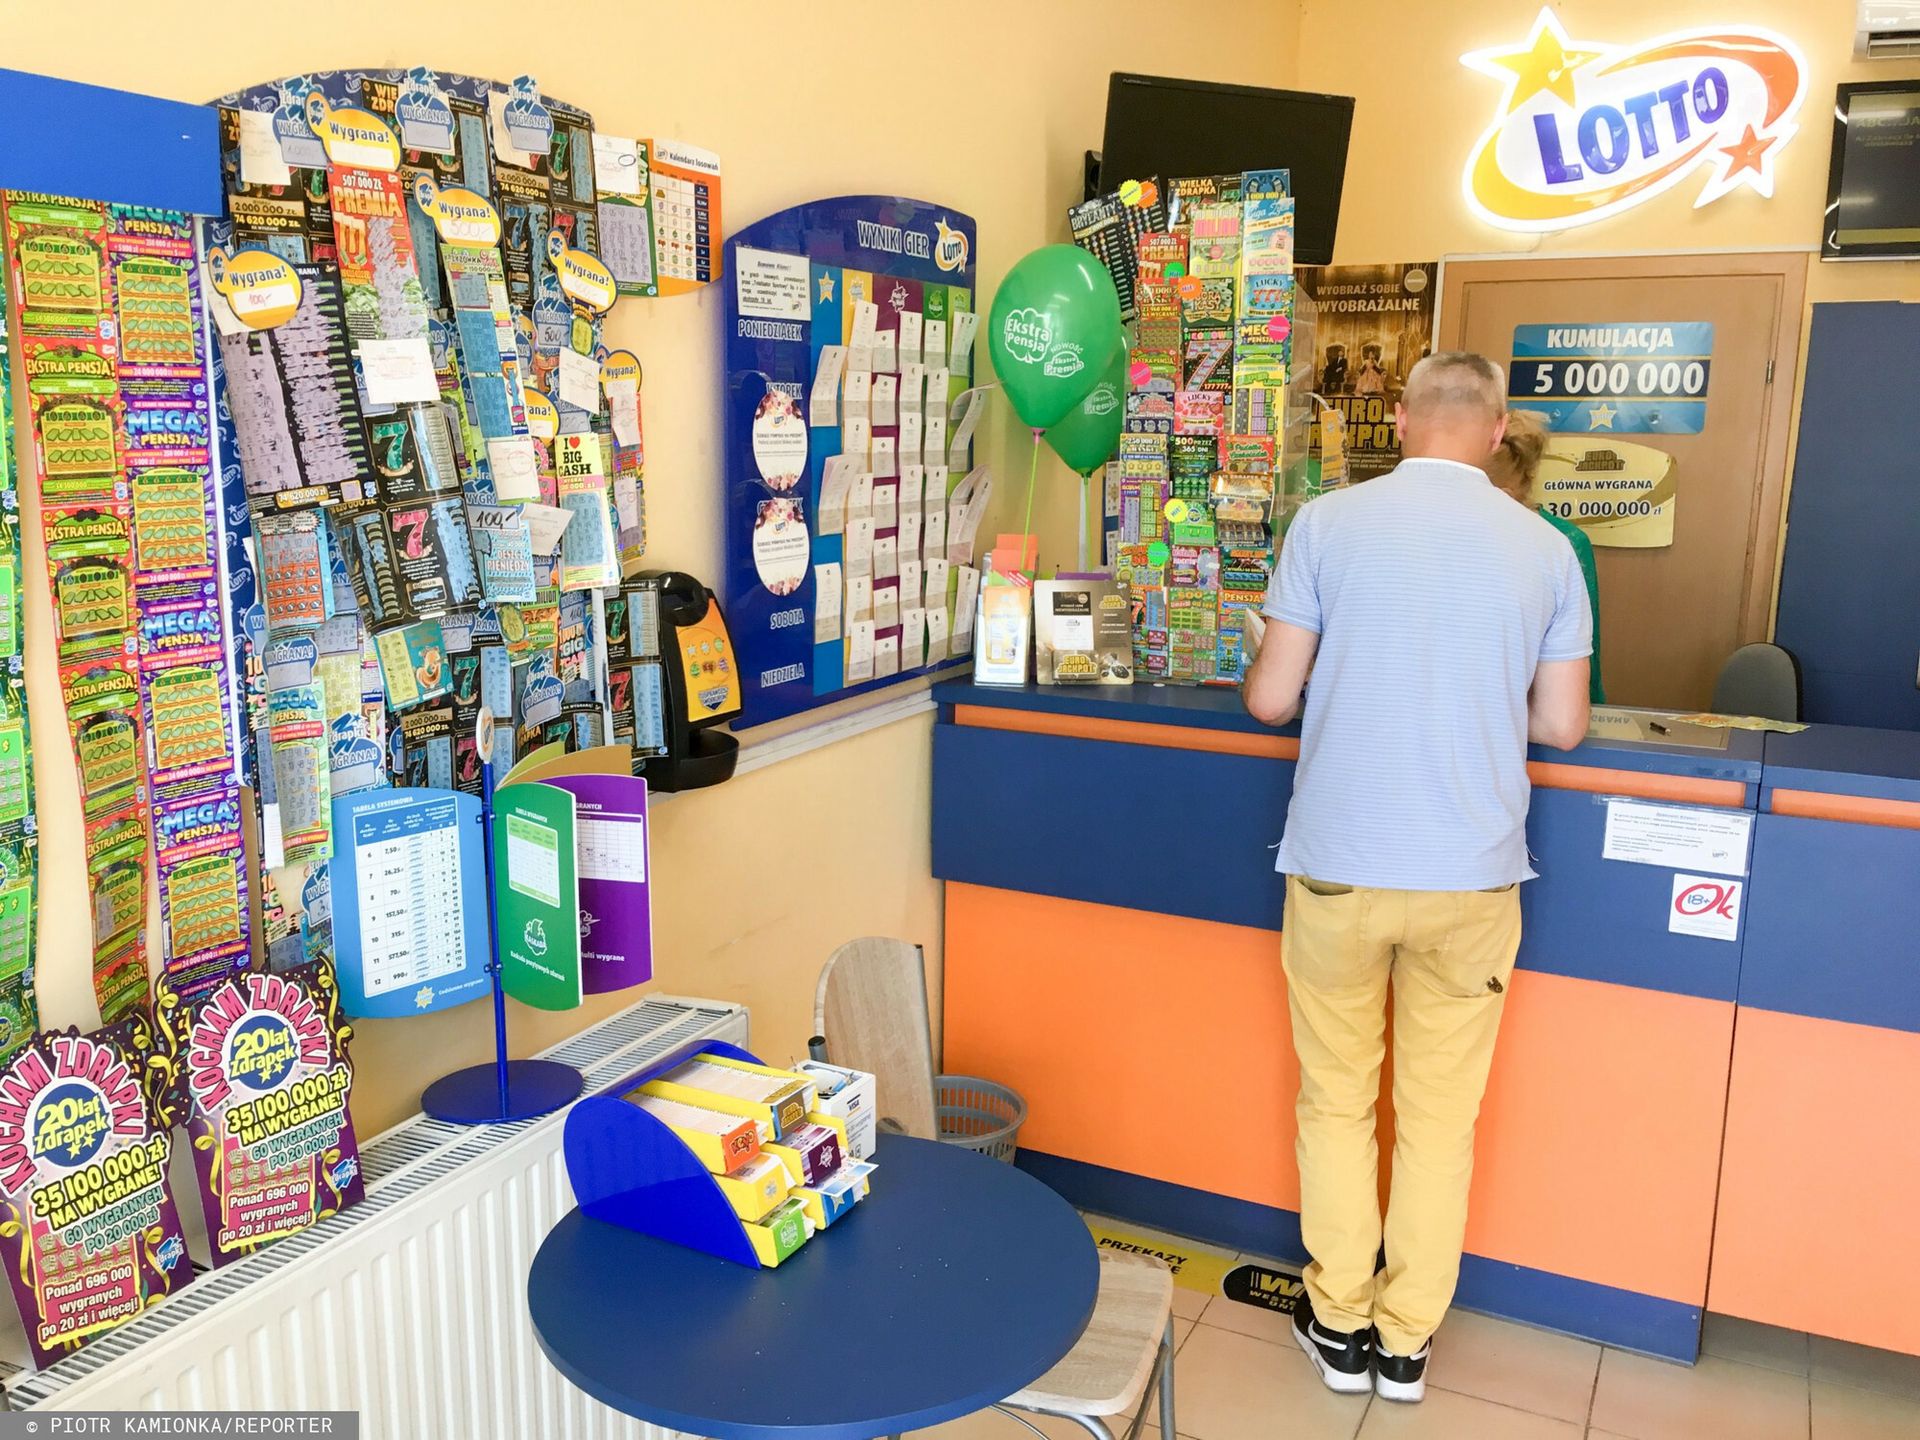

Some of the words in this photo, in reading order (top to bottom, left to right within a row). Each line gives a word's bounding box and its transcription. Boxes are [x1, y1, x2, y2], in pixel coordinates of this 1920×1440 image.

[401, 105, 450, 124] WYGRANA!
[507, 112, 551, 129] WYGRANA!
[1532, 66, 1729, 185] LOTTO
[329, 121, 391, 143] Wygrana!
[1175, 186, 1217, 197] ZDRAPKA
[1178, 179, 1213, 188] WIELKA
[6, 189, 50, 204] EKSTRA
[51, 194, 102, 212] PENSJA!
[235, 202, 241, 211] 2
[241, 202, 260, 212] 000
[263, 204, 284, 215] 000
[333, 185, 403, 217] PREMIA
[438, 202, 491, 219] Wygrana!
[124, 220, 173, 237] PENSJA
[234, 214, 245, 224] 74
[246, 215, 264, 226] 620
[266, 216, 287, 227] 000
[857, 220, 902, 254] WYNIKI
[905, 234, 931, 259] GIER
[942, 242, 962, 262] LOTTO
[1141, 245, 1185, 261] PREMIA
[229, 266, 287, 288] Wygrana!
[564, 257, 609, 286] Wygrana!
[1255, 278, 1283, 287] LUCKY
[1317, 284, 1366, 296] WYOBRAŹ
[1370, 284, 1400, 294] SOBIE
[1194, 299, 1221, 310] KASY
[1296, 296, 1420, 313] NIEWYOBRAŻALNE
[738, 319, 804, 341] PONIEDZIAŁEK
[1006, 318, 1050, 342] Ekstra
[1547, 327, 1674, 353] KUMULACJA
[1007, 332, 1045, 352] Pensja
[26, 358, 65, 376] EKSTRA
[67, 359, 116, 378] PENSJA!
[606, 365, 637, 380] Wygrana!
[1046, 361, 1084, 374] Premia
[1534, 363, 1554, 394] 5
[1564, 362, 1629, 395] 000
[1637, 362, 1705, 395] 000
[126, 410, 203, 436] MEGA
[140, 433, 191, 447] PENSJA
[564, 437, 569, 450] I
[1175, 437, 1194, 446] 500
[563, 450, 582, 464] BIG
[558, 463, 592, 478] CASH
[1544, 479, 1591, 490] GŁÓWNA
[1594, 480, 1653, 489] WYGRANA
[1537, 502, 1572, 518] 30
[1579, 502, 1612, 516] 000
[1616, 502, 1650, 516] 000
[45, 523, 85, 544] EKSTRA
[86, 519, 129, 538] PENSJA!
[1224, 592, 1262, 603] PENSJA
[144, 611, 215, 639] MEGA
[770, 608, 805, 630] SOBOTA
[157, 634, 204, 649] PENSJA
[1063, 655, 1087, 665] EURO
[761, 663, 805, 688] NIEDZIELA
[63, 683, 97, 705] EKSTRA
[98, 673, 138, 695] PENSJA!
[353, 801, 375, 813] TABELA
[376, 796, 414, 809] SYSTEMOWA
[163, 801, 234, 835] MEGA
[87, 834, 116, 859] EKSTRA
[116, 823, 147, 847] PENSJA!
[175, 825, 222, 844] PENSJA
[1675, 883, 1736, 920] Ok
[121, 962, 148, 991] PENSJA!
[190, 986, 247, 1112] KOCHAM
[249, 978, 328, 1065] ZDRAPKI
[233, 1028, 270, 1060] 20
[270, 1024, 291, 1047] lat
[226, 1101, 255, 1133] 35
[255, 1090, 290, 1121] 100
[291, 1073, 331, 1105] 000
[331, 1066, 349, 1090] zł
[0, 1052, 52, 1194] KOCHAM
[55, 1041, 144, 1135] ZDRAPKI
[38, 1098, 78, 1133] 20
[78, 1094, 101, 1118] lat
[240, 1121, 265, 1146] NA
[264, 1092, 343, 1136] WYGRANE!
[251, 1143, 268, 1160] 60
[268, 1112, 343, 1149] WYGRANYCH
[269, 1155, 287, 1170] PO
[288, 1147, 305, 1162] 20
[304, 1138, 327, 1156] 000
[327, 1130, 338, 1146] zł
[33, 1182, 64, 1216] 35
[64, 1165, 103, 1200] 100
[104, 1145, 146, 1181] 000
[147, 1134, 167, 1161] zł
[51, 1203, 79, 1230] NA
[78, 1164, 162, 1215] WYGRANE!
[230, 1192, 263, 1208] Ponad
[266, 1187, 286, 1201] 696
[289, 1182, 309, 1196] 000
[64, 1226, 83, 1246] 60
[82, 1186, 163, 1236] WYGRANYCH
[240, 1200, 298, 1222] wygranych
[85, 1236, 106, 1255] PO
[105, 1226, 124, 1243] 20
[122, 1213, 147, 1237] 000
[147, 1207, 159, 1224] zł
[222, 1230, 236, 1244] po
[238, 1225, 252, 1237] 20
[255, 1221, 265, 1233] zł
[268, 1220, 272, 1231] i
[274, 1211, 311, 1231] więcej!
[1099, 1238, 1188, 1265] PRZEKAZY
[45, 1279, 83, 1300] Ponad
[86, 1272, 108, 1290] 696
[110, 1265, 132, 1282] 000
[59, 1286, 122, 1314] wygranych
[41, 1323, 57, 1340] po
[59, 1317, 75, 1332] 20
[78, 1312, 89, 1328] zł
[91, 1310, 96, 1323] i
[99, 1297, 139, 1319] więcej!
